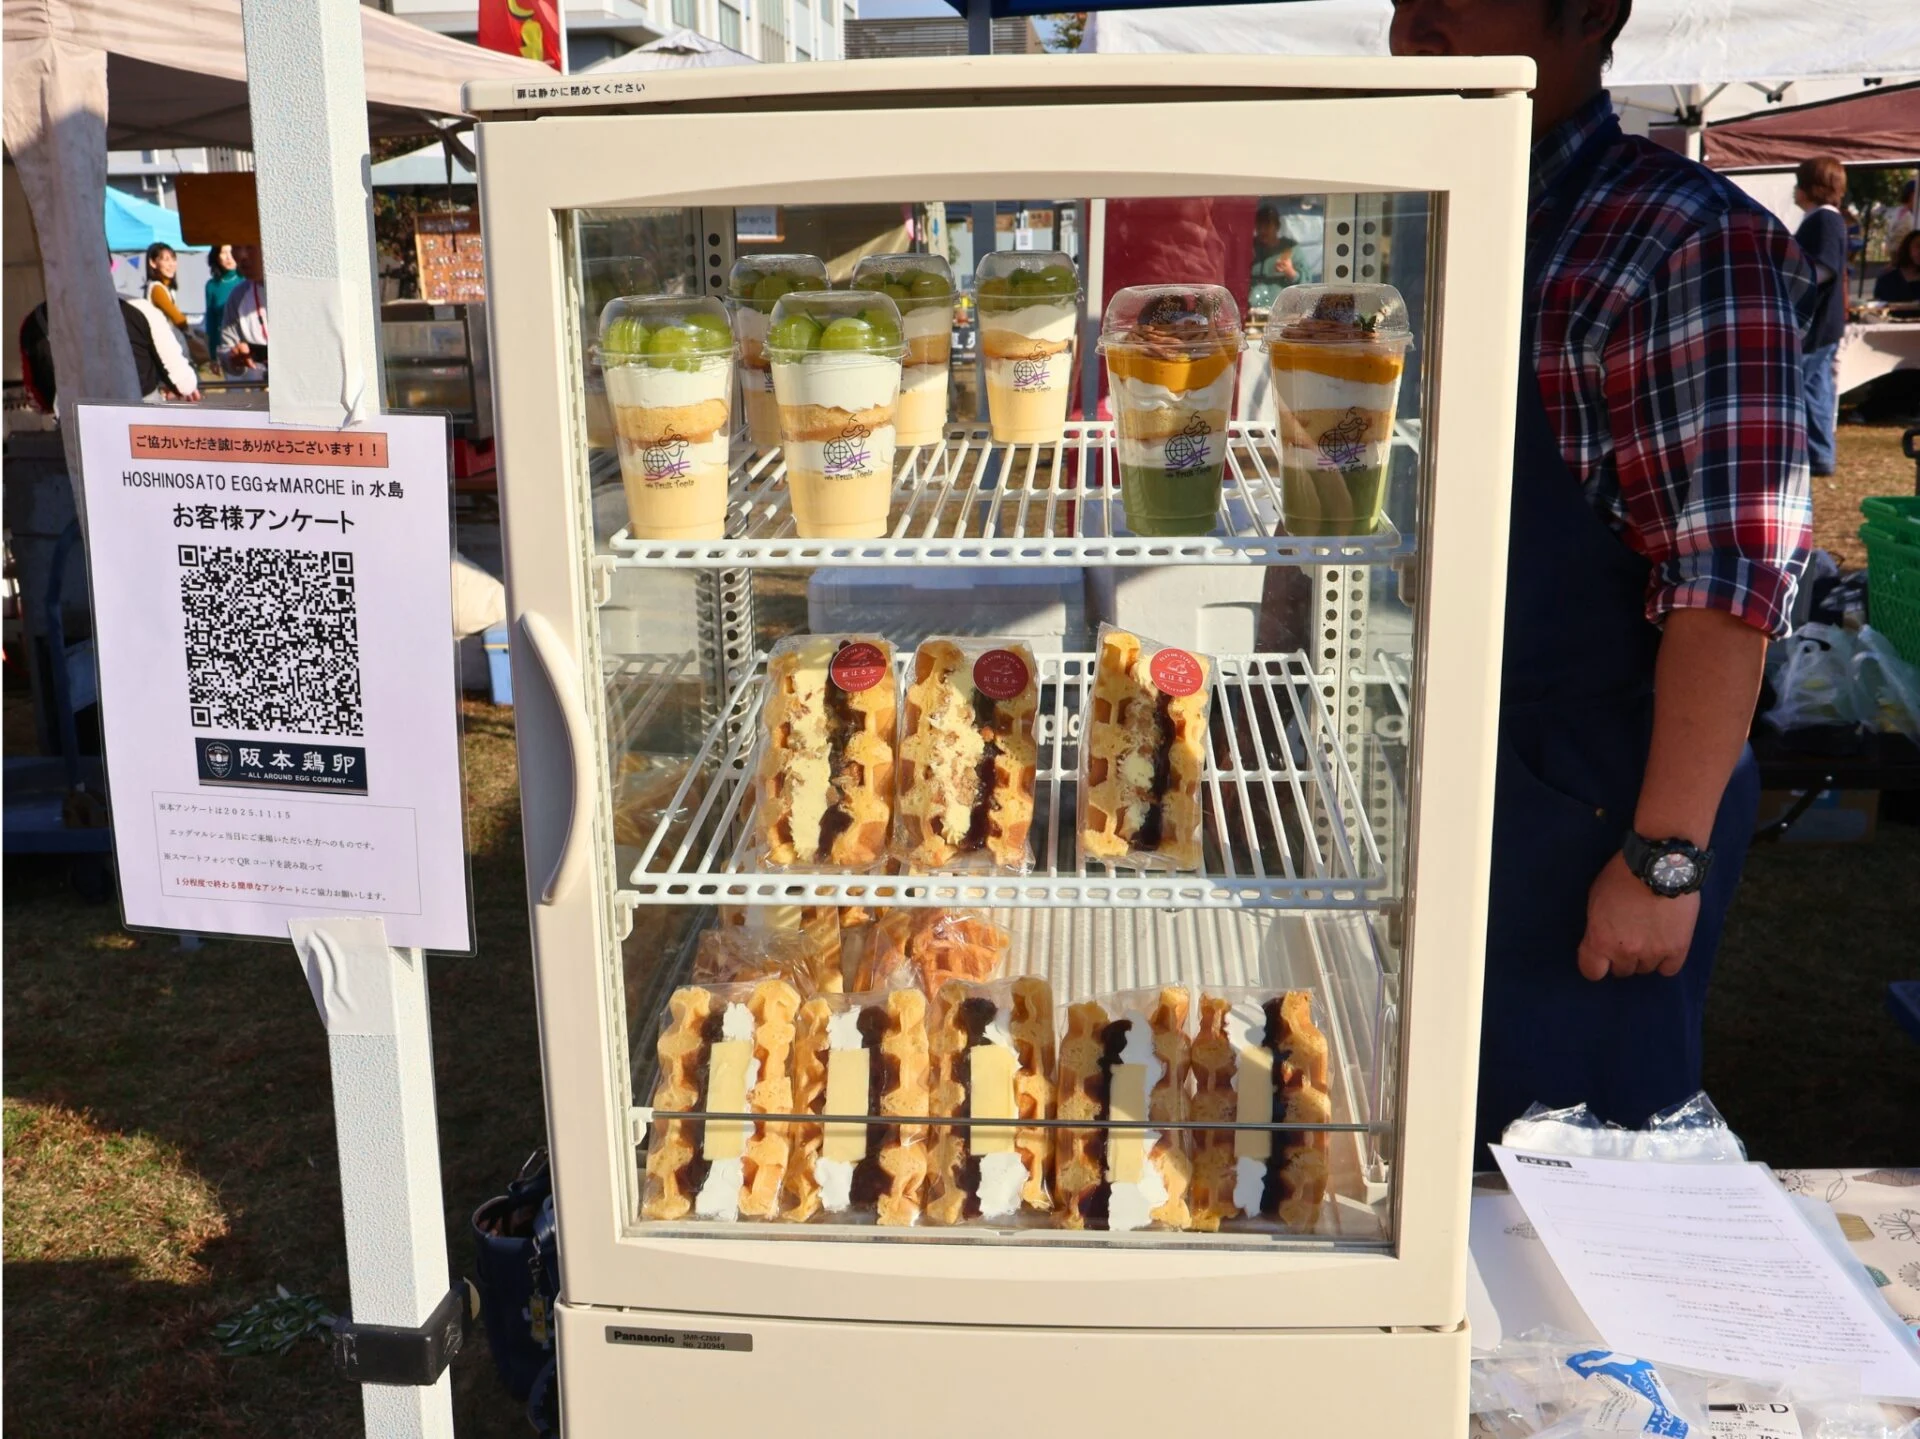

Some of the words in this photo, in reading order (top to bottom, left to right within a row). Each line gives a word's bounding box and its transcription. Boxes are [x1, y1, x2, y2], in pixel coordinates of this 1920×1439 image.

[516, 83, 646, 99] 扉は静かに閉めてください
[135, 434, 378, 458] ご協力いただき誠にありがとうございます！！
[122, 471, 226, 491] HOSHINOSATO
[351, 481, 364, 496] in
[369, 481, 404, 499] 水島
[172, 502, 355, 534] お客様アンケート
[239, 747, 356, 775] 阪本鶏卵
[263, 773, 293, 781] AROUND
[295, 774, 310, 782] EGG
[312, 775, 346, 784] COMPANY
[614, 1331, 675, 1344] Panasonic
